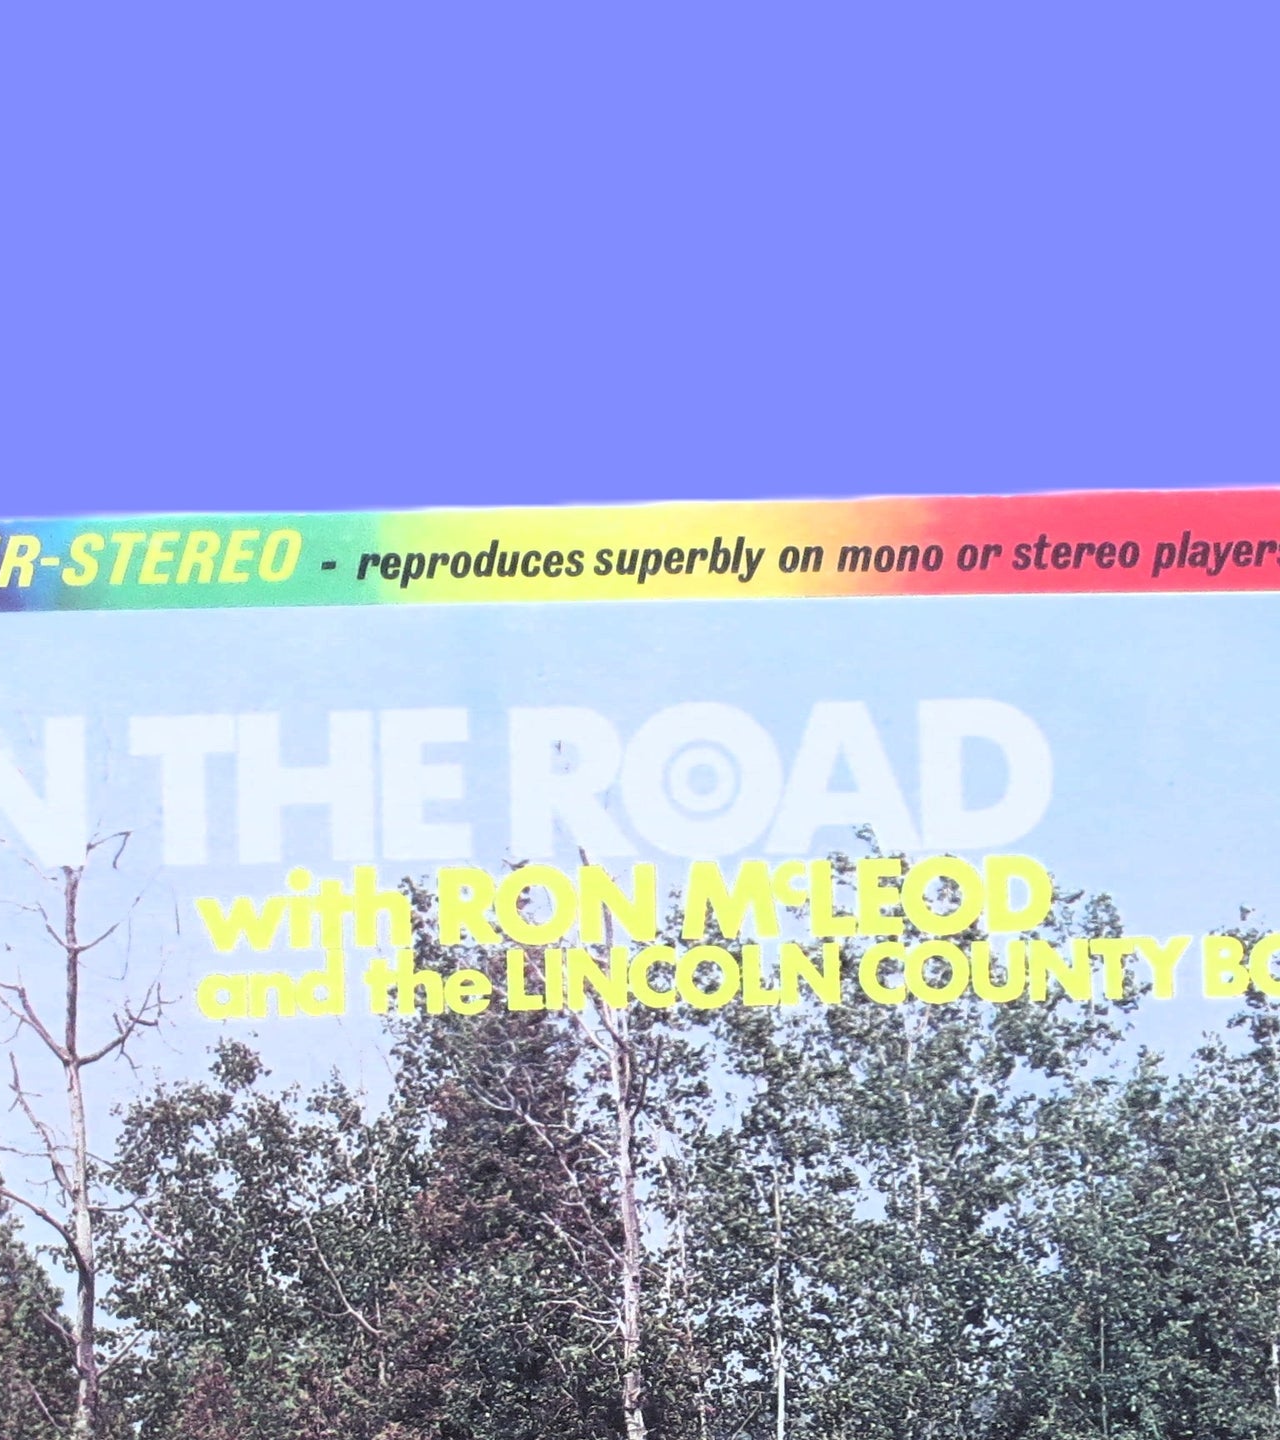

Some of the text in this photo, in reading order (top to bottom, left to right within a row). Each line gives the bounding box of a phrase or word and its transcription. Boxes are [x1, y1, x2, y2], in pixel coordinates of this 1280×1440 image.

[356, 540, 585, 589] reproduces
[593, 536, 765, 584] superbly
[779, 544, 822, 573] on
[838, 543, 944, 573] mono
[956, 544, 1002, 571] or
[1011, 534, 1140, 570] stereo
[129, 708, 470, 866] THE
[509, 699, 1053, 858] ROAD
[197, 855, 1052, 951] with RON McLEOD
[197, 948, 345, 1019] and
[364, 948, 492, 1015] the
[508, 941, 841, 1011] LINCOLN
[858, 935, 1191, 1003] COUNTY
